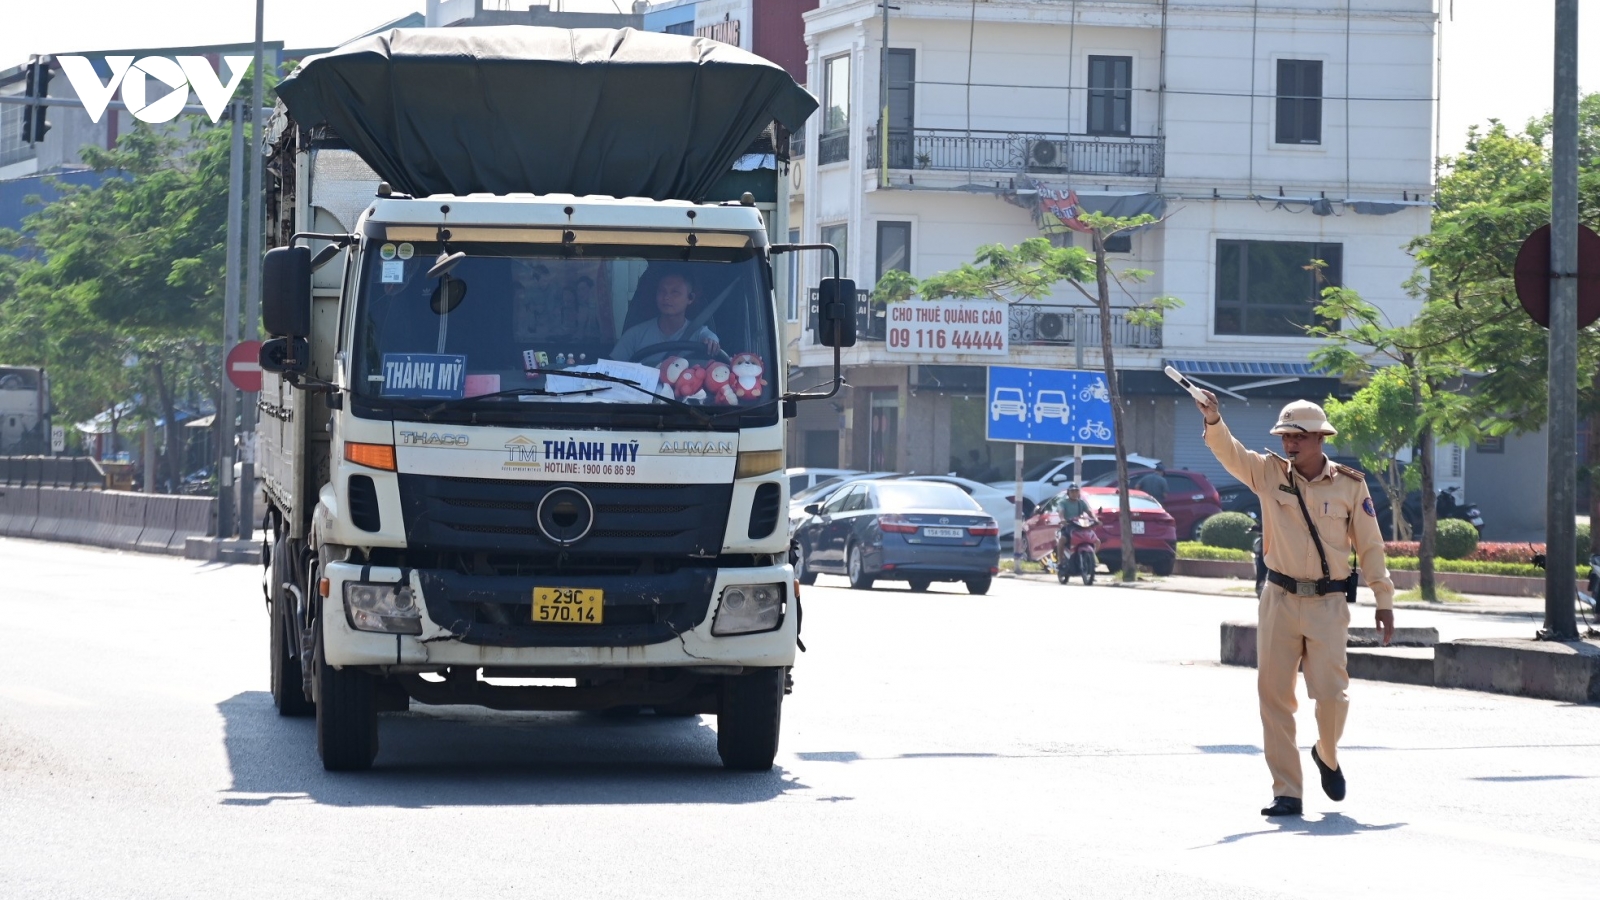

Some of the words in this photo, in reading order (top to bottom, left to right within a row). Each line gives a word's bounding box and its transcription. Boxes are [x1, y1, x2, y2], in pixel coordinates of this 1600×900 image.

[892, 307, 912, 322] CHO
[916, 305, 941, 323] THUÊ
[944, 304, 979, 325] QUẢNG
[982, 307, 1002, 325] CÁO
[889, 328, 910, 348] 09
[916, 329, 946, 349] 116
[952, 330, 1003, 350] 44444
[386, 355, 435, 389] THÀNH
[437, 358, 462, 391] MỸ
[400, 431, 469, 446] THACO
[504, 444, 537, 462] TM
[543, 437, 604, 461] THÀNH
[611, 439, 639, 463] MỸ
[659, 441, 733, 455] AUMAN
[544, 462, 581, 474] HOTLINE:
[582, 464, 601, 475] 1900
[603, 465, 612, 475] 06
[614, 465, 624, 476] 86
[626, 465, 636, 476] 99
[553, 589, 583, 605] 29C
[540, 605, 595, 622] 570.14
